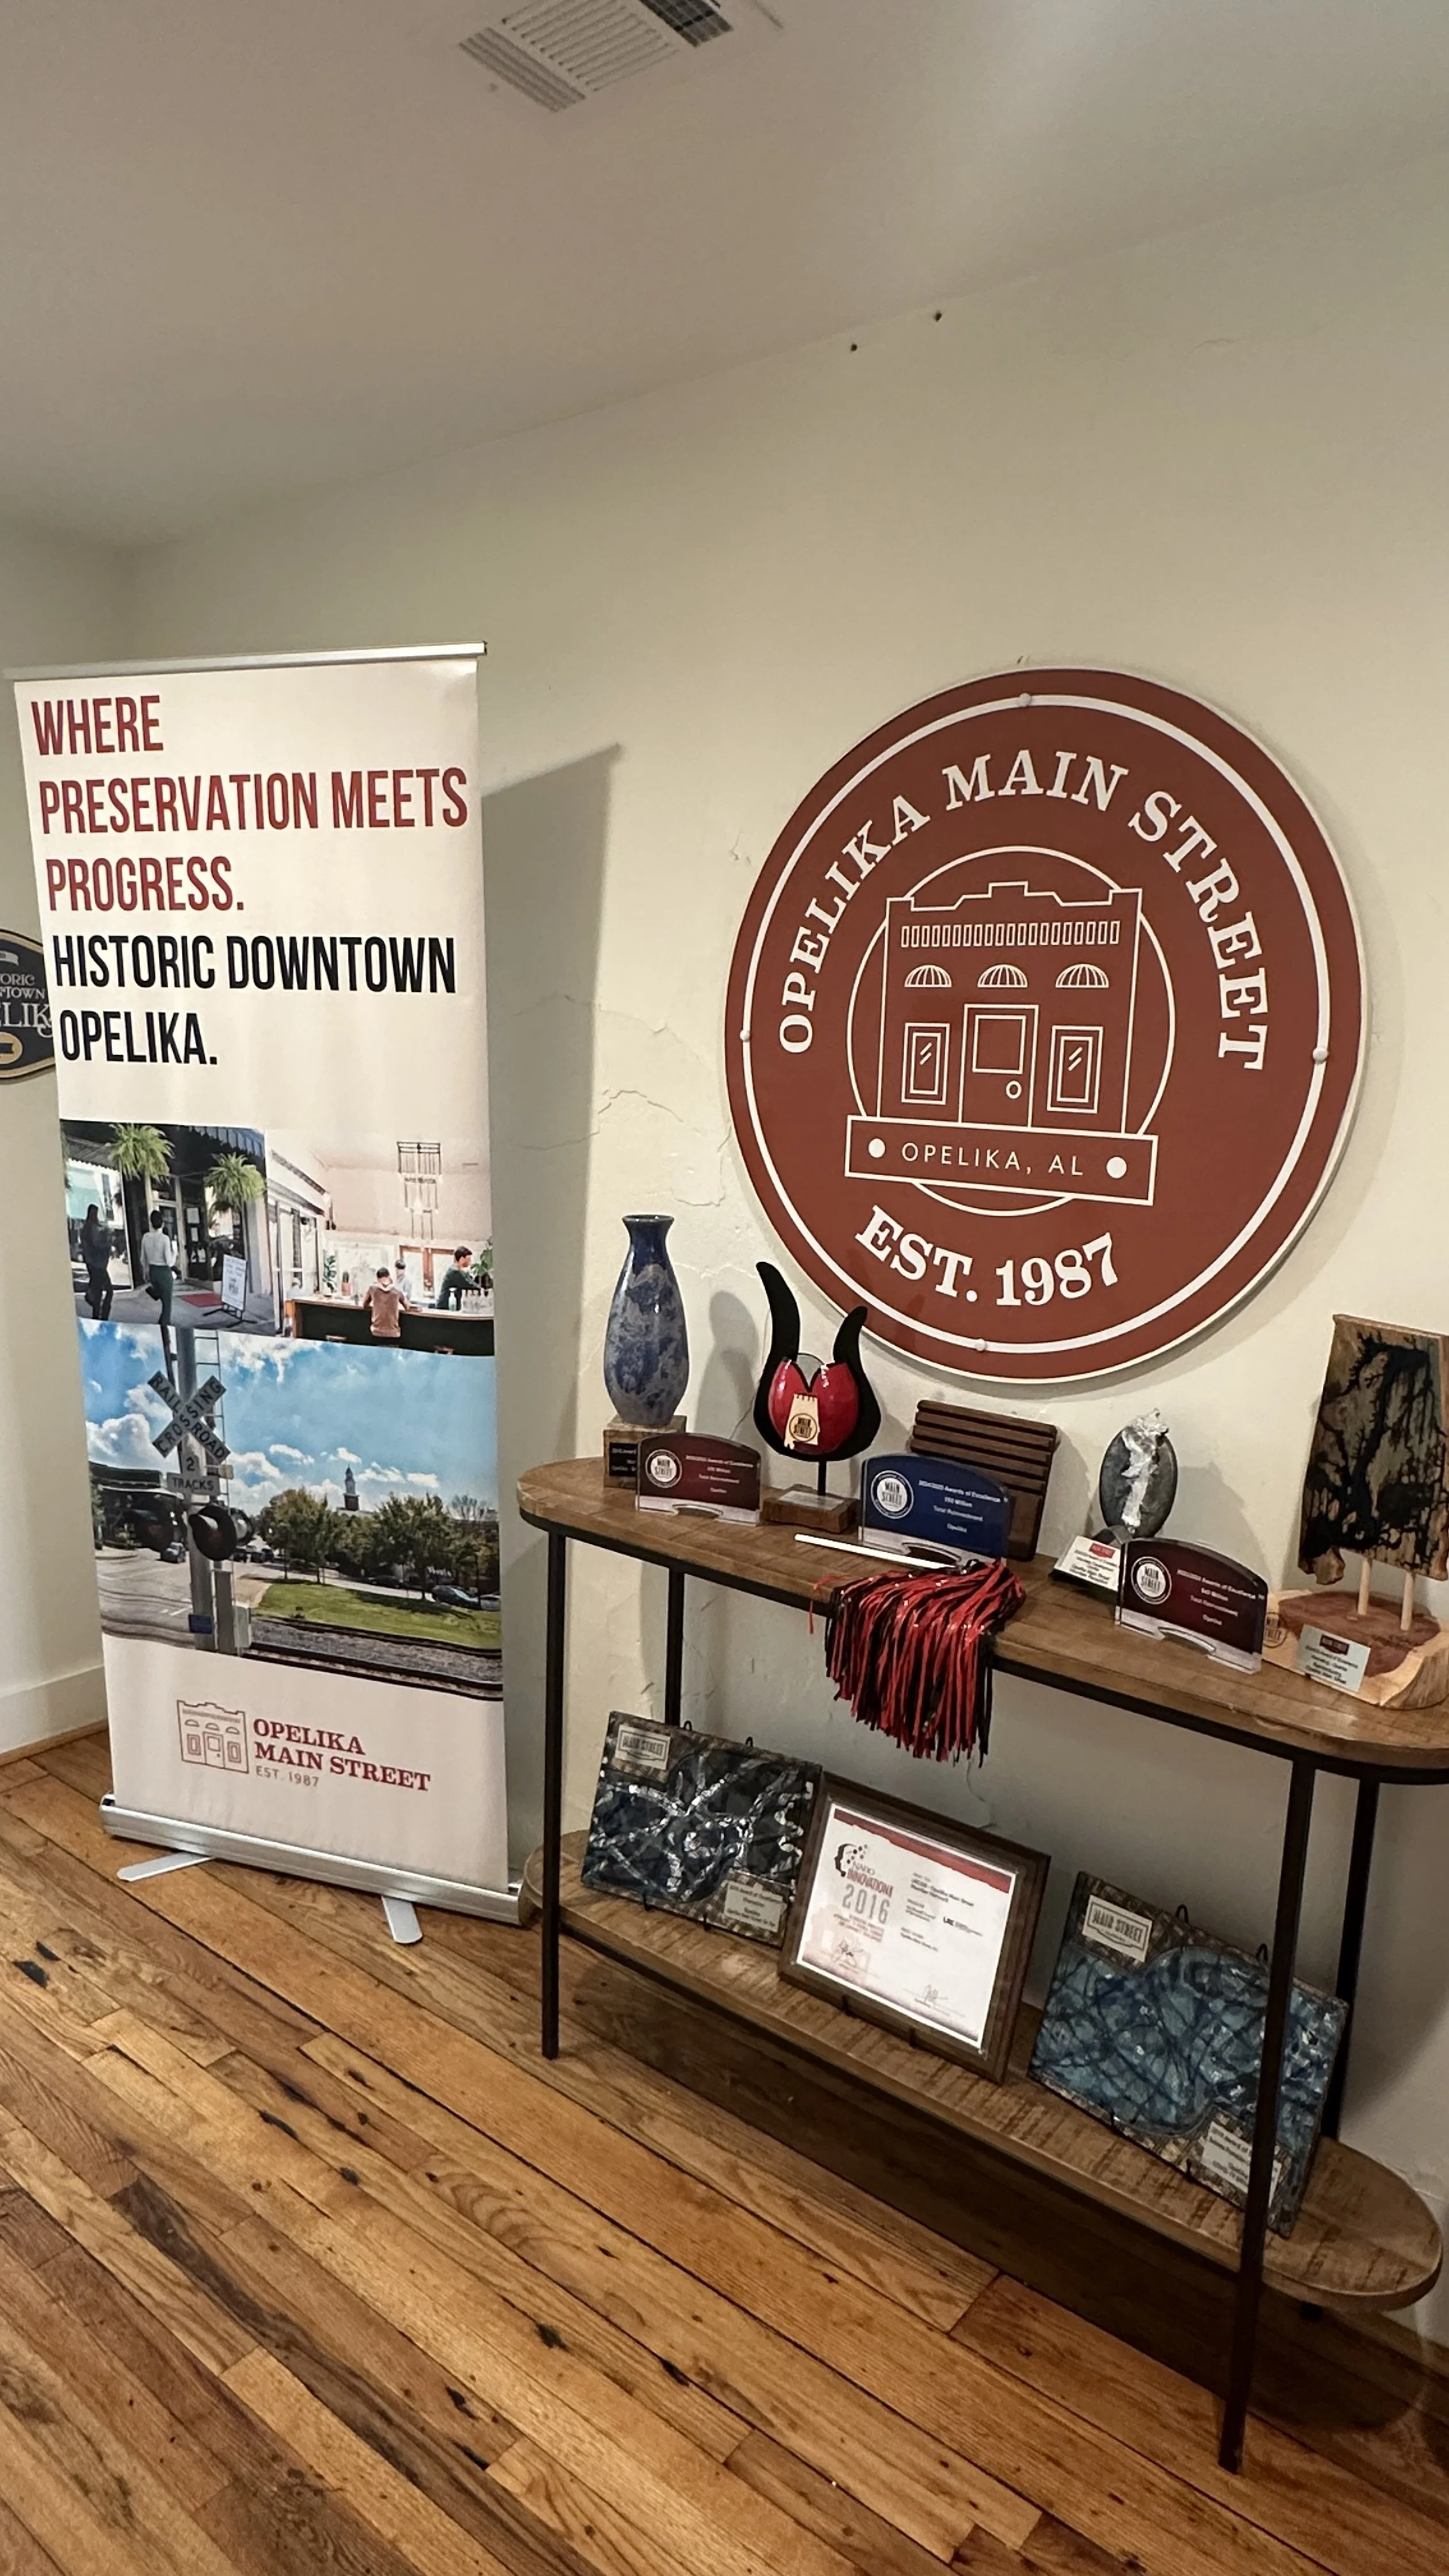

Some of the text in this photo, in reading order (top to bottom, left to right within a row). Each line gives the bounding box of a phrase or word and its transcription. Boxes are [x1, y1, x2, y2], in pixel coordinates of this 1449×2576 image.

[31, 694, 164, 756] WHERE
[39, 767, 468, 834] PRESERVATION MEETS
[45, 855, 244, 912] PROGRESS.
[779, 749, 1268, 1070] OPELIKA MAIN STREET
[52, 935, 456, 994] HISTORIC DOWNTOWN
[59, 1009, 217, 1065] OPELIKA.
[901, 1142, 1084, 1176] OPELIKA, AL
[855, 1205, 1118, 1306] EST. 1987
[151, 1375, 225, 1460] RAIL ROAD
[158, 1379, 222, 1453] CROSSING
[172, 1477, 214, 1491] TRACKS
[185, 1455, 195, 1472] 2
[882, 1491, 902, 1505] STREET
[884, 1481, 900, 1494] MAIN
[1144, 1565, 1159, 1579] MAIN
[253, 1719, 366, 1756] OPELIKA
[254, 1741, 431, 1791] MAIN STREET
[288, 1771, 319, 1787] 1987
[841, 1883, 891, 1924] 2016
[1091, 1908, 1114, 1929] MAIN
[1115, 1918, 1144, 1943] STREET
